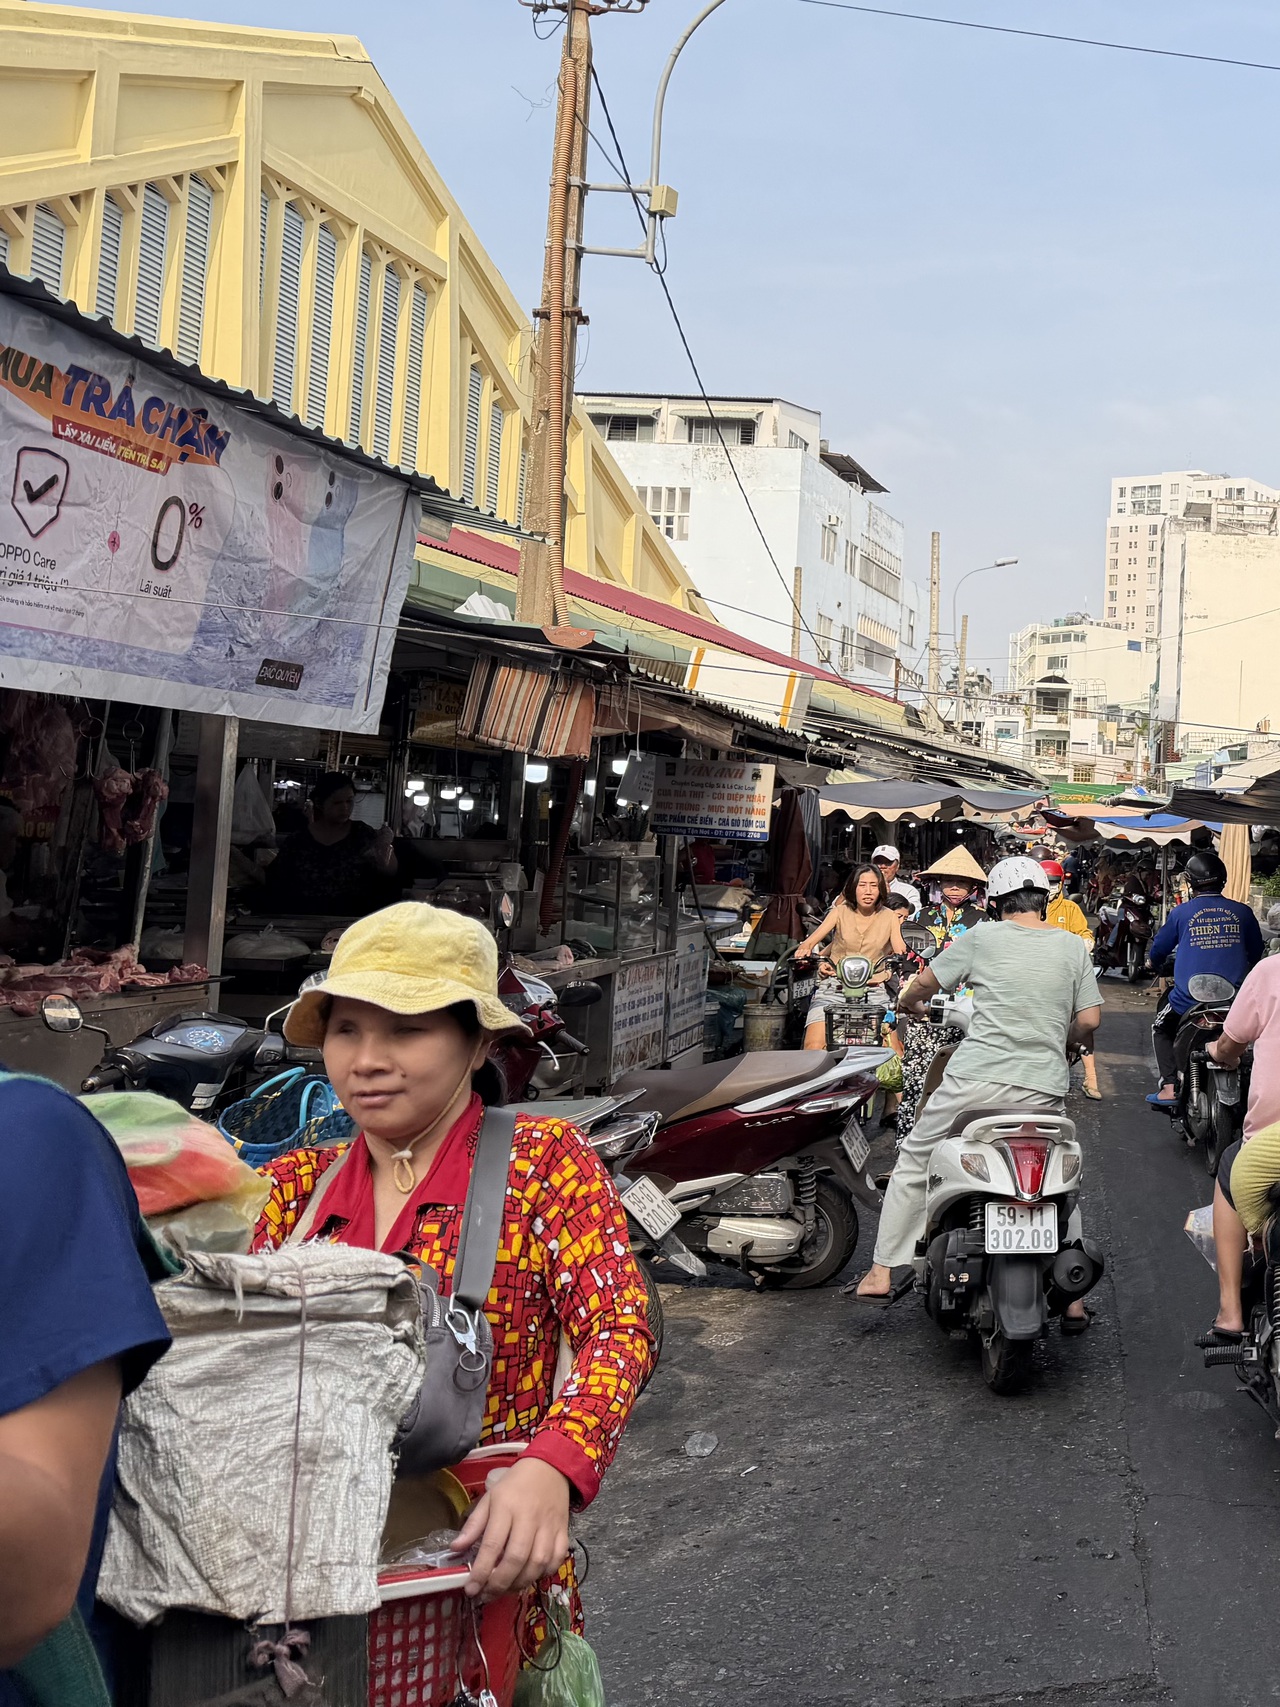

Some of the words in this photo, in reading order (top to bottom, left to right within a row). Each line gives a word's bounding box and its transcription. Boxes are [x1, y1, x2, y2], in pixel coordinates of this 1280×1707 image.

[62, 363, 136, 427] TRẢ
[141, 396, 231, 466] CHẬM
[58, 422, 78, 439] LẤY
[79, 431, 96, 446] XÀI
[33, 551, 57, 570] Care
[152, 584, 172, 598] suất
[276, 668, 300, 684] QUYỀN
[657, 788, 671, 797] CUA
[689, 790, 705, 800] THỊT
[746, 794, 766, 804] NHẬT
[642, 1200, 677, 1236] 870.10
[997, 1206, 1044, 1226] 59-T1
[990, 1229, 1054, 1250] 302.08
